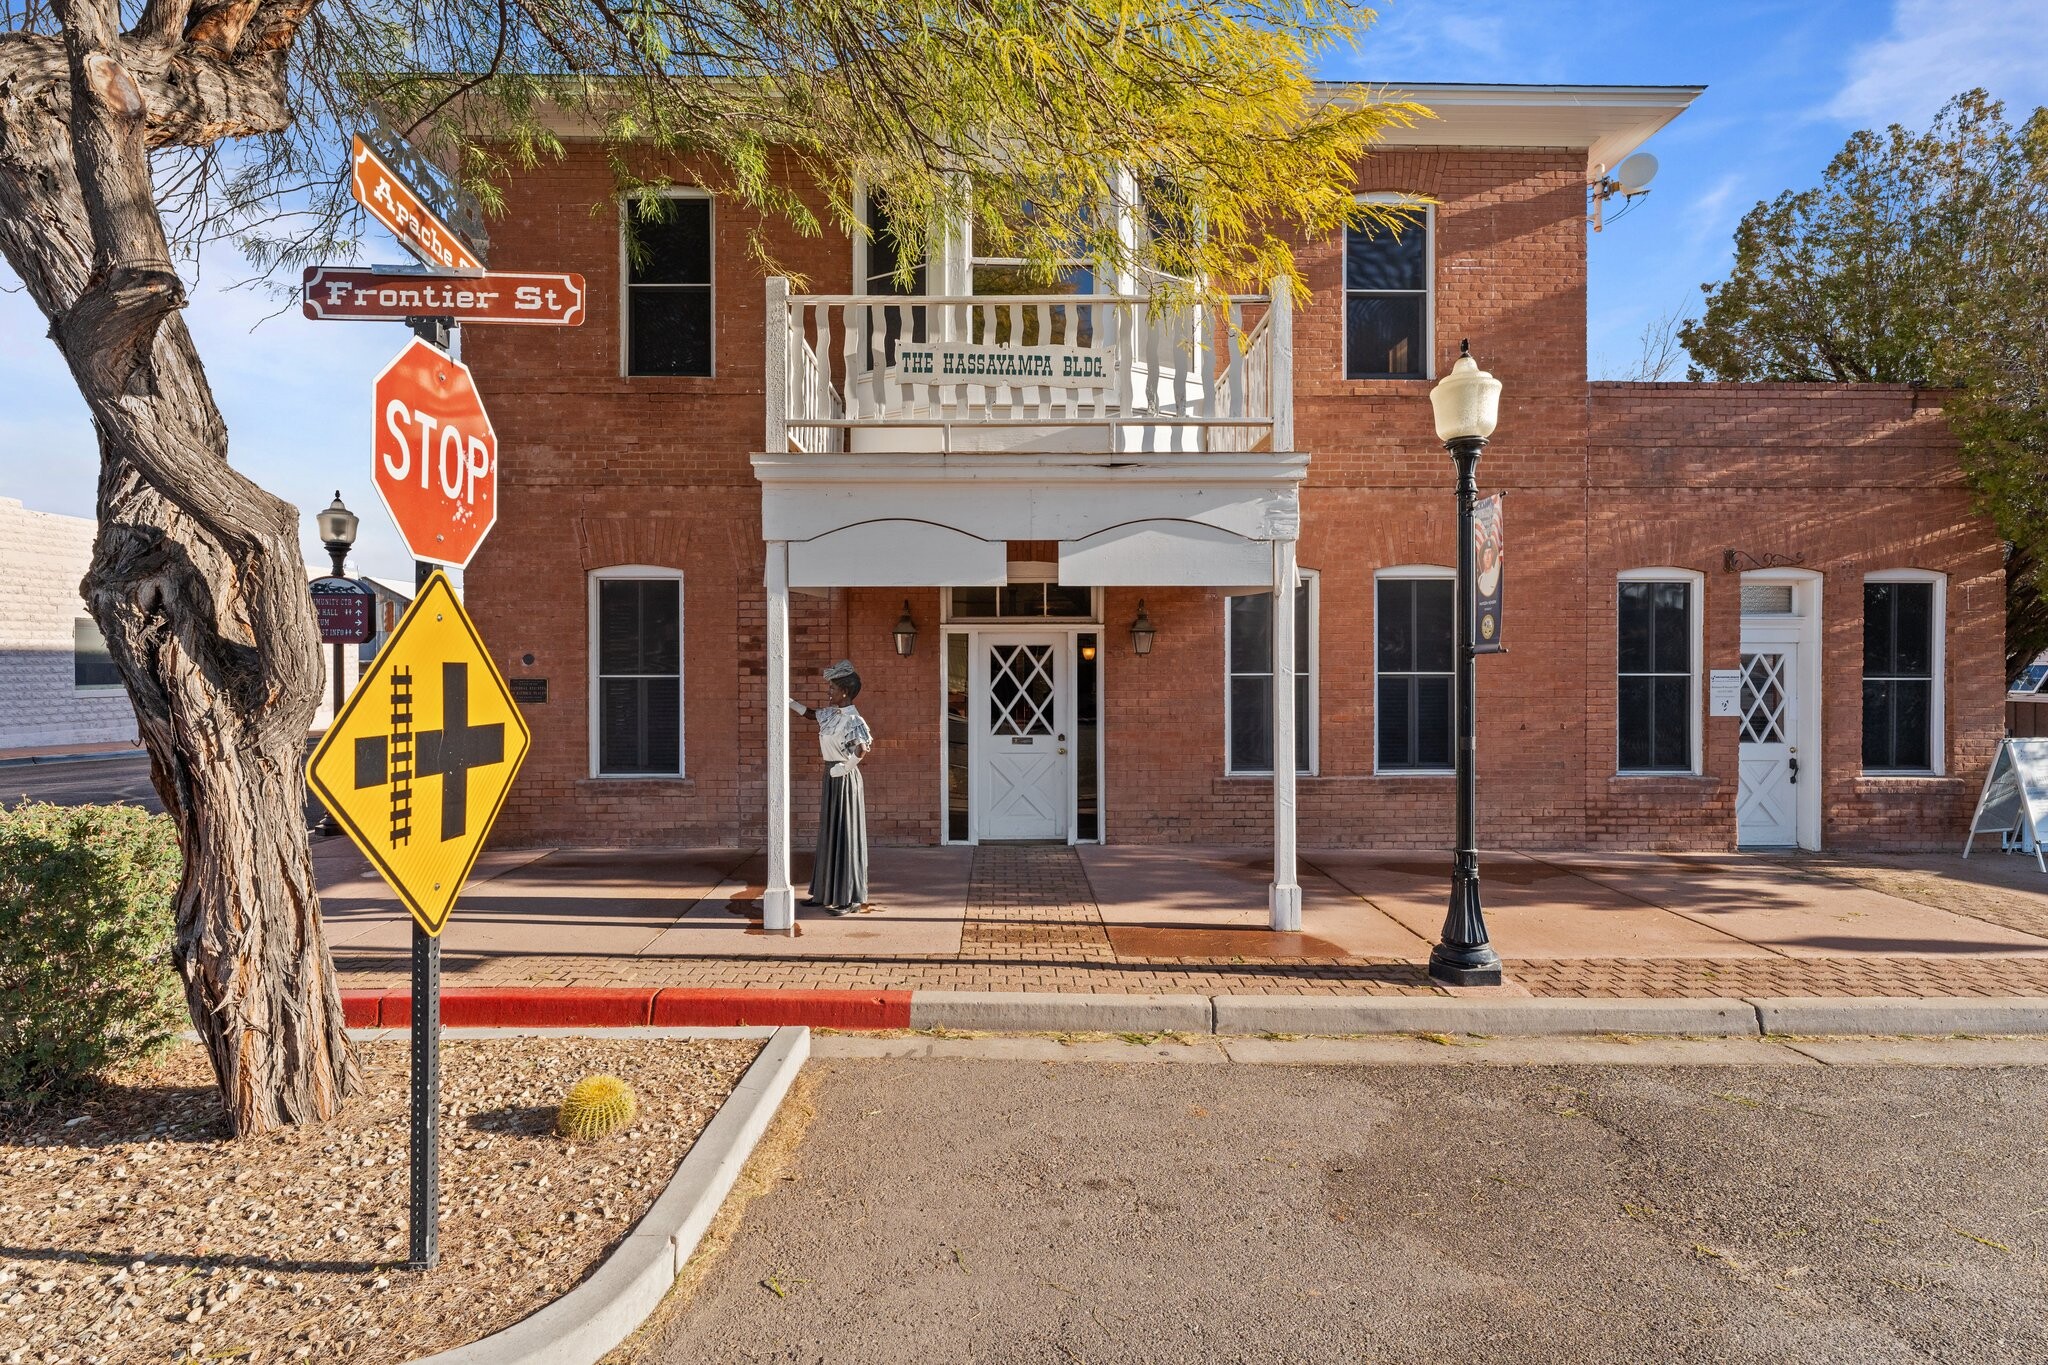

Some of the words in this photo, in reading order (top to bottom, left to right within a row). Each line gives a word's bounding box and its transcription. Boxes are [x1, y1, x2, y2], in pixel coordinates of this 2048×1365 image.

[373, 177, 453, 268] Apache
[325, 281, 499, 309] Frontier
[514, 286, 562, 310] St
[902, 352, 934, 374] THE
[943, 353, 1053, 376] HASSAYAMPA
[1063, 355, 1107, 378] BLDG.
[383, 399, 489, 505] STOP
[313, 598, 339, 606] MUNITY
[322, 608, 338, 616] HALL
